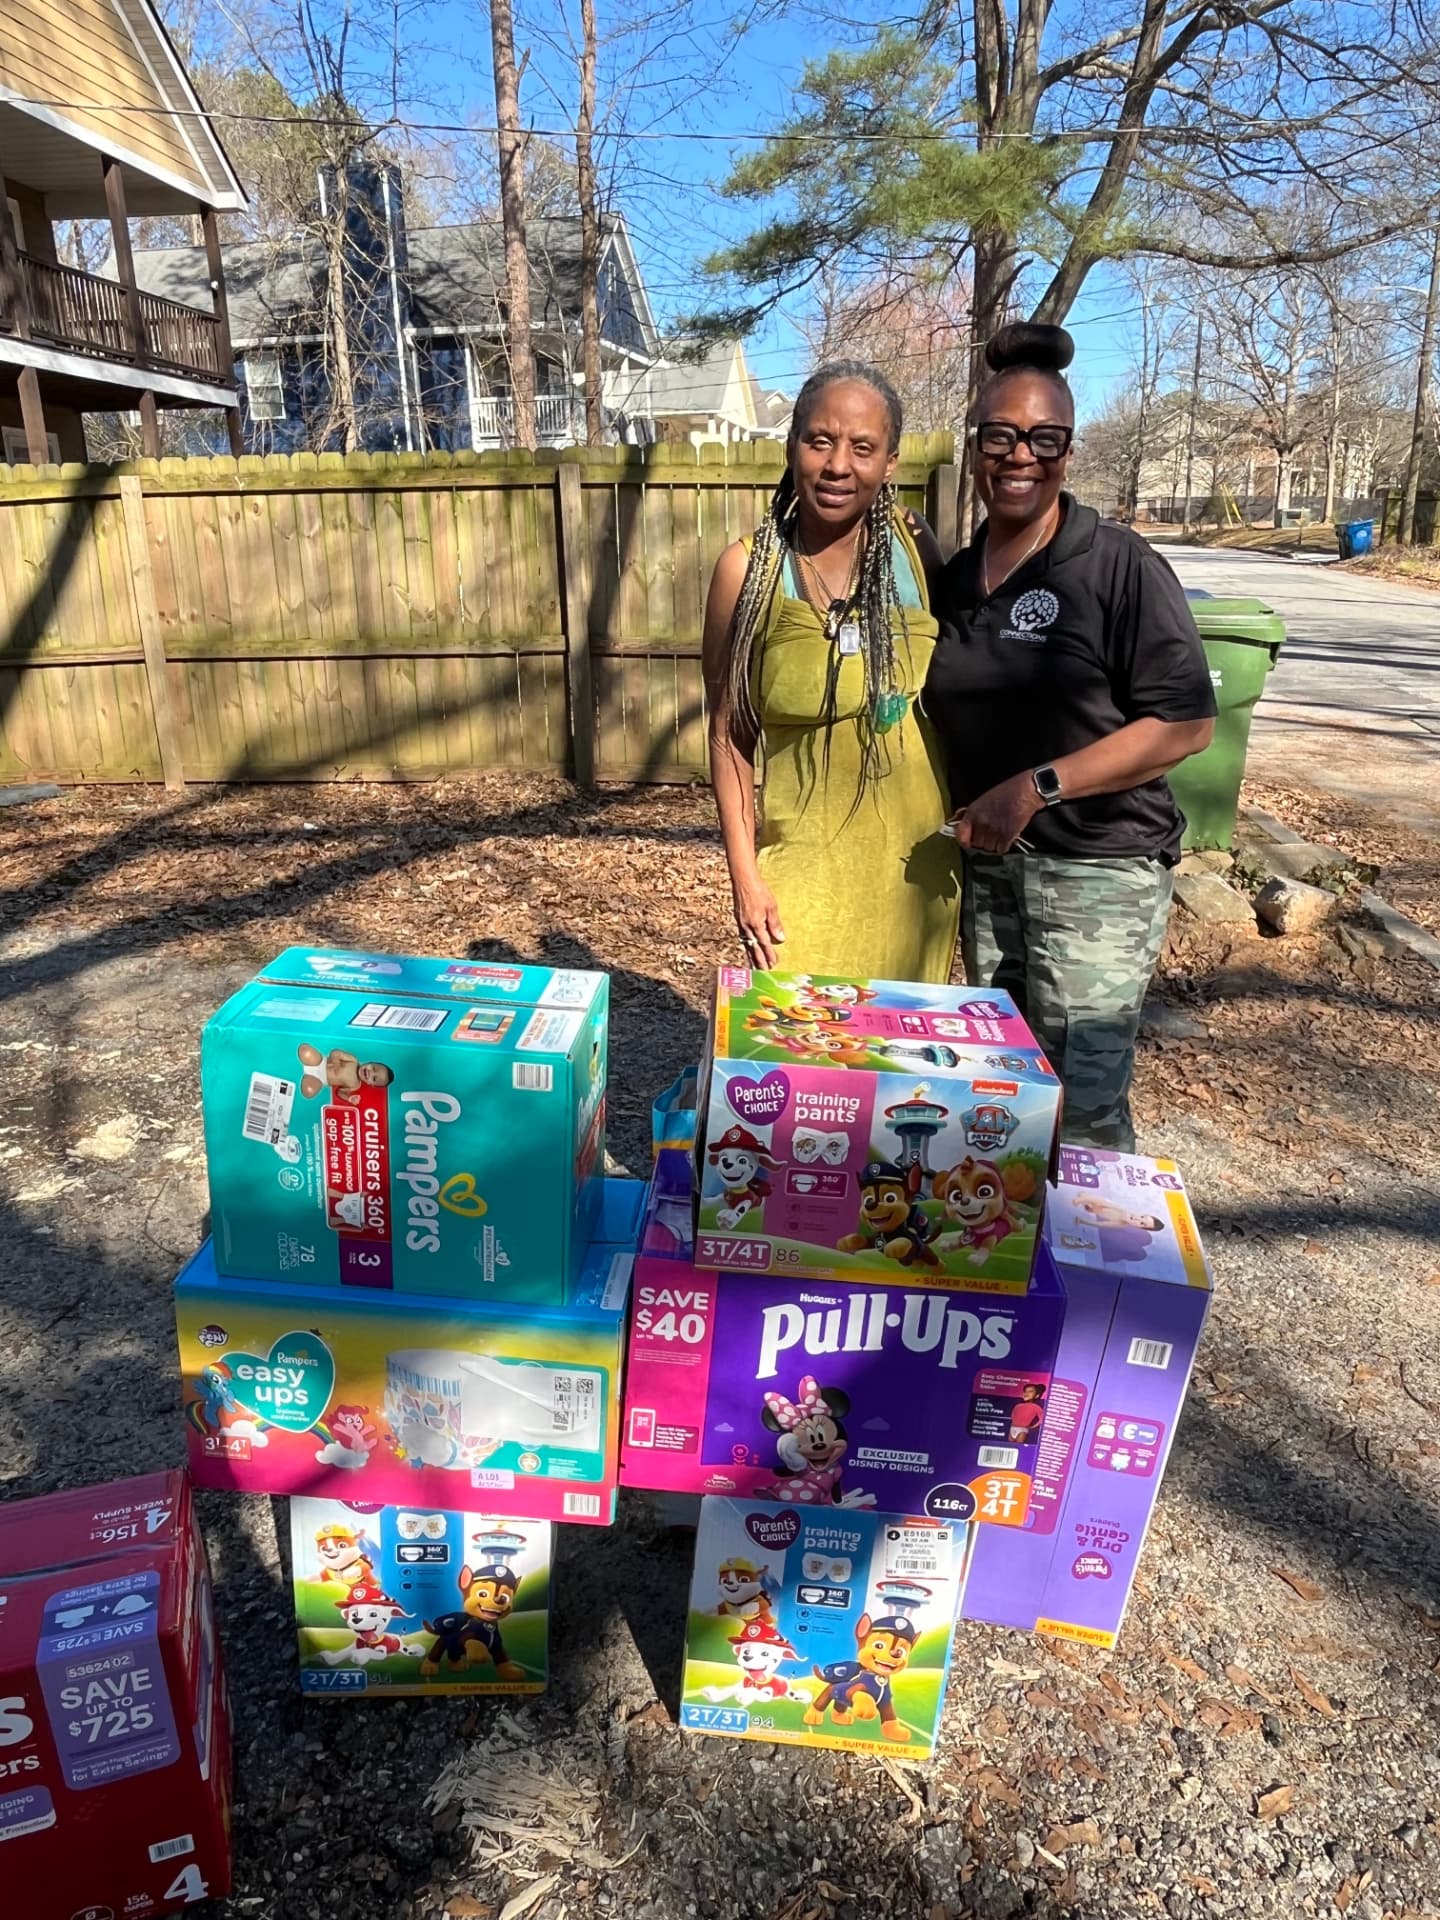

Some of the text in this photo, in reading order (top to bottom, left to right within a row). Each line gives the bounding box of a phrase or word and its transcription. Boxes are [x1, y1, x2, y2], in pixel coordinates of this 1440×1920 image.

[734, 1079, 785, 1103] Parent's
[744, 1101, 779, 1114] CHOICE
[795, 1092, 861, 1109] training
[794, 1105, 857, 1123] pants
[326, 1118, 342, 1184] gap-free fit
[364, 1108, 385, 1191] cruisers
[400, 1091, 461, 1254] Pampers
[300, 1245, 315, 1263] 78
[358, 1252, 380, 1267] 3
[702, 1240, 768, 1260] 3T/4T
[775, 1248, 800, 1263] 86
[923, 1276, 1001, 1291] SUPER VALUE
[638, 1287, 710, 1311] SAVE
[277, 1352, 319, 1367] Pampers
[236, 1363, 305, 1388] easy
[254, 1385, 309, 1408] ups
[862, 1449, 924, 1463] EXCLUSIVE
[848, 1459, 935, 1475] DISNEY DESIGNS
[983, 1479, 1021, 1500] 3T
[92, 1506, 132, 1520] SUPPLY
[134, 1500, 165, 1513] WEEK
[981, 1499, 1018, 1518] 4T
[144, 1507, 172, 1533] 4
[752, 1517, 797, 1535] Parent's
[760, 1531, 792, 1542] CHOICE
[804, 1526, 862, 1543] training
[1075, 1523, 1130, 1543] Gentle
[803, 1537, 858, 1552] pants
[1077, 1535, 1123, 1554] Dry &
[1075, 1562, 1109, 1576] Parent's
[103, 1622, 144, 1641] SAVE
[308, 1672, 362, 1687] 2T/3T
[460, 1684, 527, 1693] SUPER VALUE
[60, 1668, 152, 1710] SAVE
[86, 1697, 133, 1716] UP TO
[688, 1708, 746, 1727] 2T/3T
[752, 1714, 774, 1729] 94
[842, 1740, 911, 1755] SUPER VALUE
[72, 1750, 170, 1782] for Extra Savings
[8, 1805, 25, 1817] FIT
[163, 1863, 209, 1903] 4
[127, 1892, 149, 1906] 156
